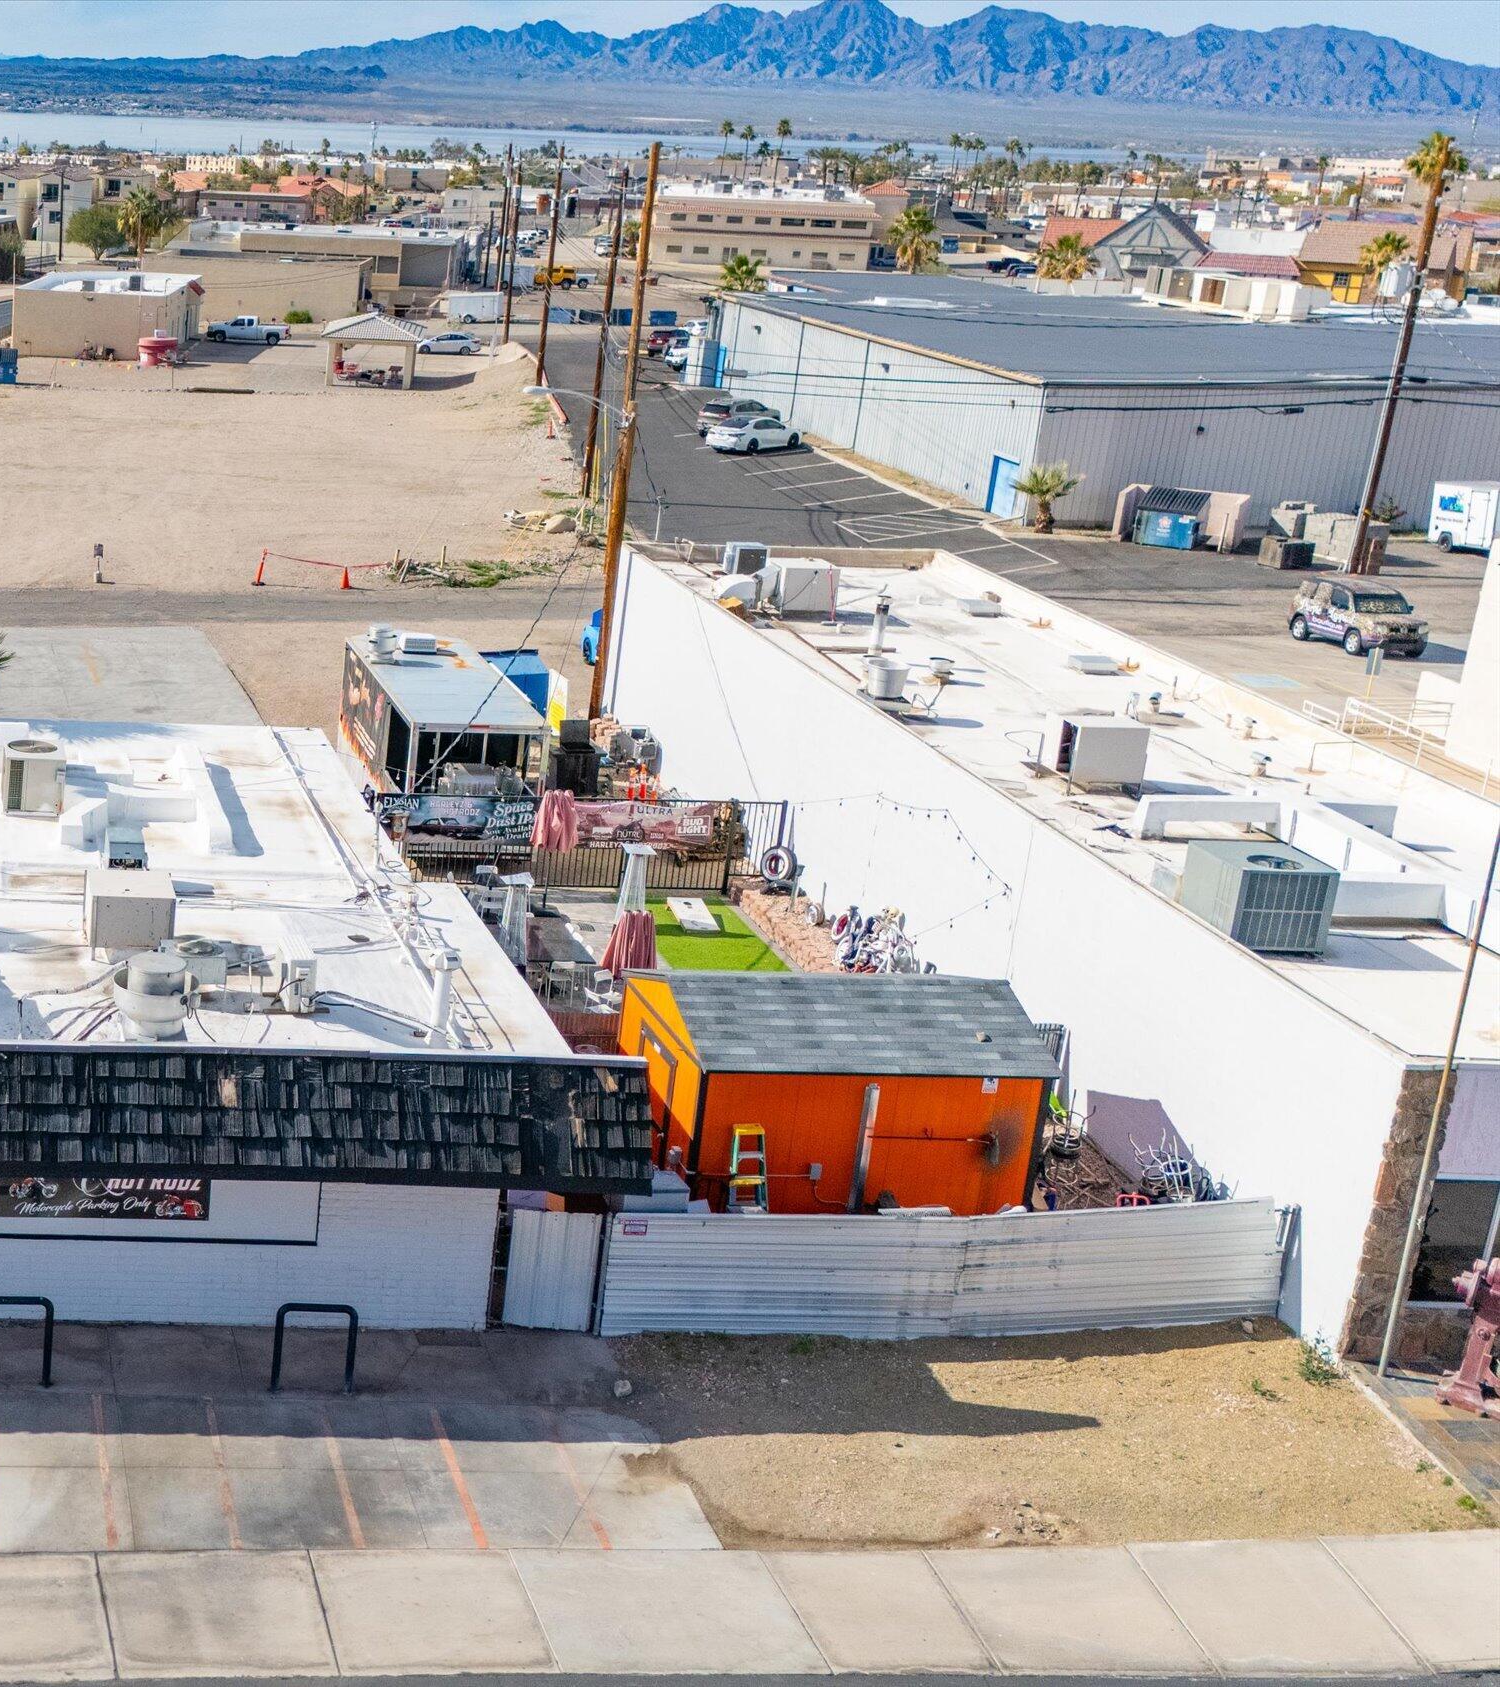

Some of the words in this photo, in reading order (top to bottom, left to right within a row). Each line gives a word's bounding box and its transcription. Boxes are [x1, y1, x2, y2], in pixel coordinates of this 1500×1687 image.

[383, 796, 420, 810] ELYSIAN
[636, 805, 674, 816] ULTRA
[486, 815, 516, 828] Dust
[683, 817, 704, 826] BUD
[677, 825, 708, 834] LIGHT
[14, 1200, 74, 1216] Motorcycle
[75, 1198, 120, 1214] Parking
[123, 1196, 152, 1212] Only
